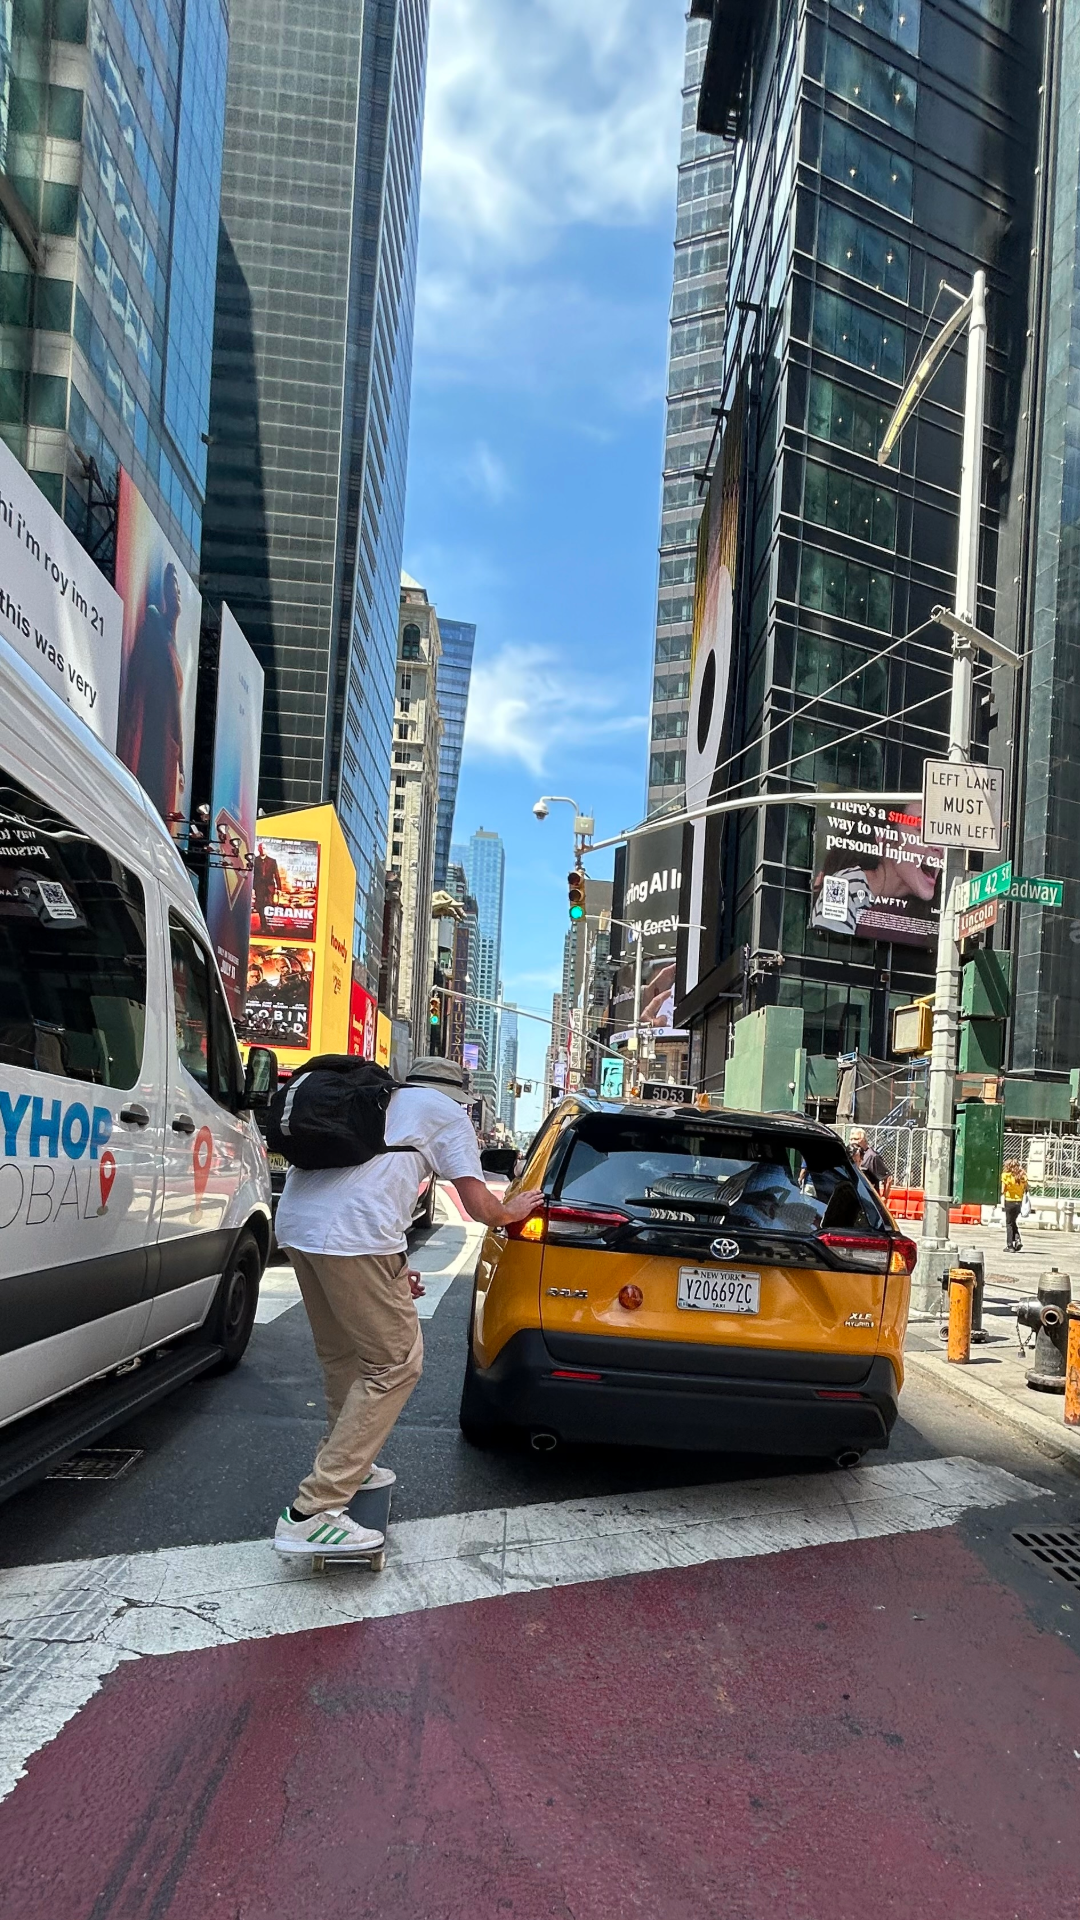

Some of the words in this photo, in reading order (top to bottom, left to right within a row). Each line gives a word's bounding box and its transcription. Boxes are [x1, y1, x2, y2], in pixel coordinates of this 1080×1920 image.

[0, 491, 13, 528] hi
[18, 513, 40, 561] i'm
[45, 552, 68, 596] roy
[73, 581, 87, 618] im
[91, 606, 104, 637] 21
[0, 587, 30, 638] this
[35, 628, 64, 672] was
[68, 663, 97, 708] very
[932, 772, 960, 787] LEFT
[967, 776, 997, 791] LANE
[878, 808, 886, 820] a
[943, 796, 983, 815] MUST
[827, 816, 855, 835] way
[857, 820, 871, 834] to
[874, 825, 898, 841] win
[901, 832, 929, 848] you
[930, 821, 961, 836] TURN
[968, 825, 996, 839] LEFT
[826, 835, 883, 857] personal
[885, 844, 925, 868] injury
[972, 880, 981, 902] W
[985, 872, 998, 894] 42
[1001, 866, 1010, 882] St
[264, 906, 314, 920] CRANK
[868, 895, 908, 909] LAWFTY
[961, 904, 994, 930] Lincoln
[331, 925, 348, 963] howdy
[652, 1087, 685, 1104] 5D53
[0, 1090, 112, 1160] YHOP
[700, 1271, 718, 1280] NEW
[719, 1273, 740, 1281] YORK
[686, 1278, 752, 1304] Y206692C
[849, 1312, 873, 1320] XLE
